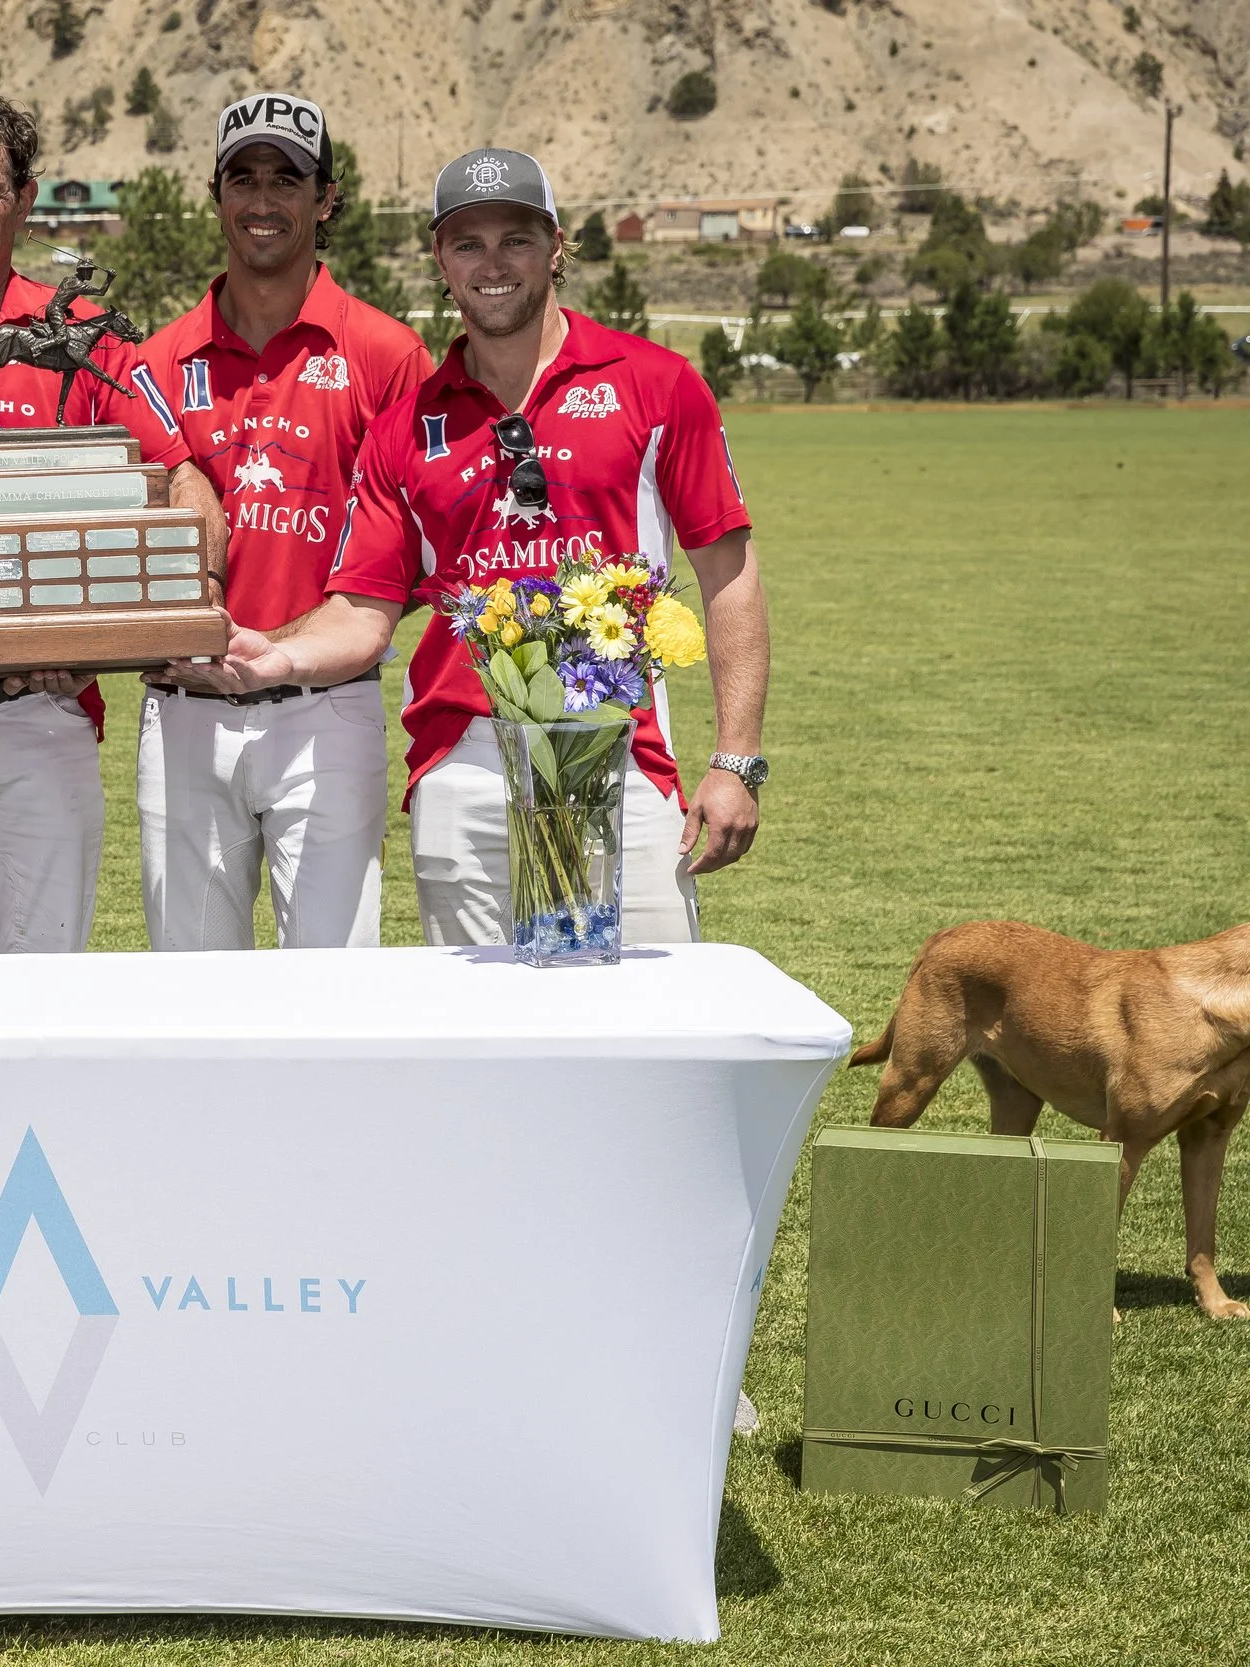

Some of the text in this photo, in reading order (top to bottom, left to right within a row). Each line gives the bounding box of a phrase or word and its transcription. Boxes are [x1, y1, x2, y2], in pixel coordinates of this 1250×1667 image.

[221, 97, 319, 144] AVPC
[471, 157, 502, 169] BUSCH
[572, 411, 607, 419] POLO
[210, 416, 310, 445] RANCHO
[14, 454, 49, 466] VALLEY
[460, 445, 572, 482] RANHO
[36, 488, 110, 501] CHALLENGE
[114, 488, 139, 498] CUP
[141, 1275, 367, 1314] VALLEY
[894, 1398, 1016, 1426] GUCCI
[86, 1431, 188, 1448] CLUB
